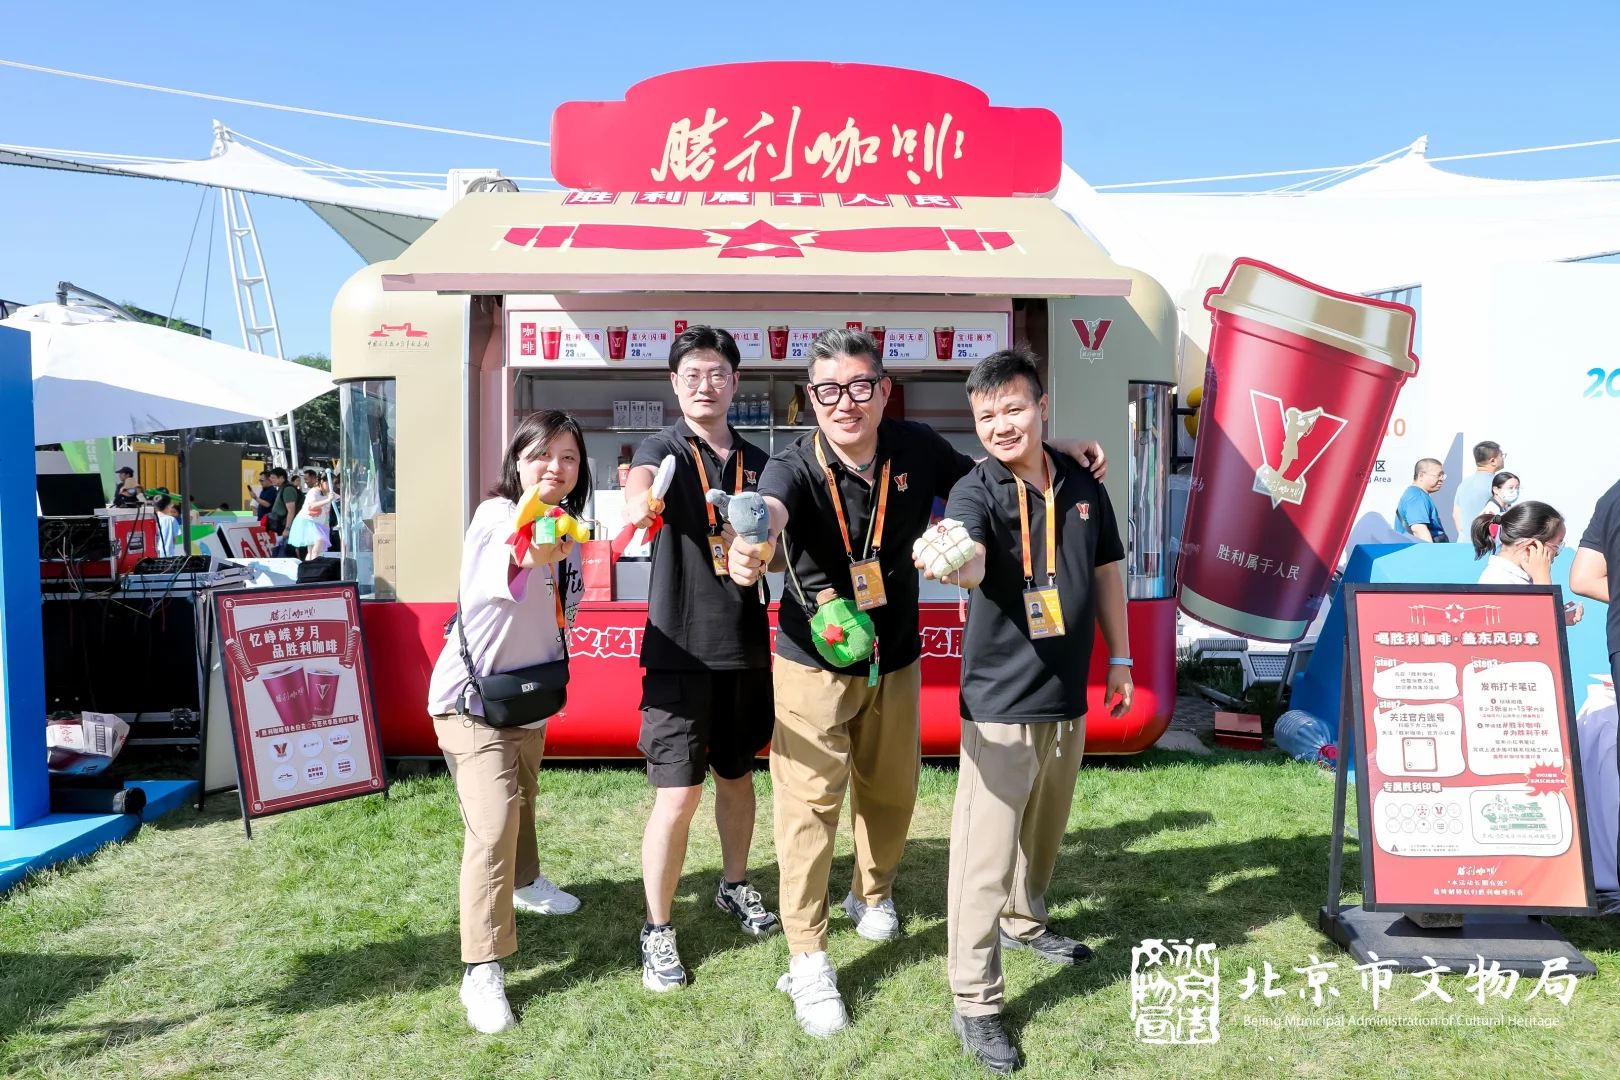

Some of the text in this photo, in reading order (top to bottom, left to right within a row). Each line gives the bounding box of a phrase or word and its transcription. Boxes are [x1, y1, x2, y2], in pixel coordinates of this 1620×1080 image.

[522, 325, 535, 354] 咖啡
[565, 349, 575, 357] 23
[631, 348, 641, 357] 28
[792, 348, 802, 357] 23
[889, 348, 899, 357] 25
[957, 349, 967, 357] 25
[1373, 475, 1392, 483] Area
[1216, 543, 1300, 582] 胜利属于人民
[272, 639, 338, 659] 品胜利咖啡
[1481, 682, 1537, 692] 发布打卡笔记
[1390, 713, 1445, 722] 关注官方账号
[1383, 781, 1443, 793] 专属胜利印章
